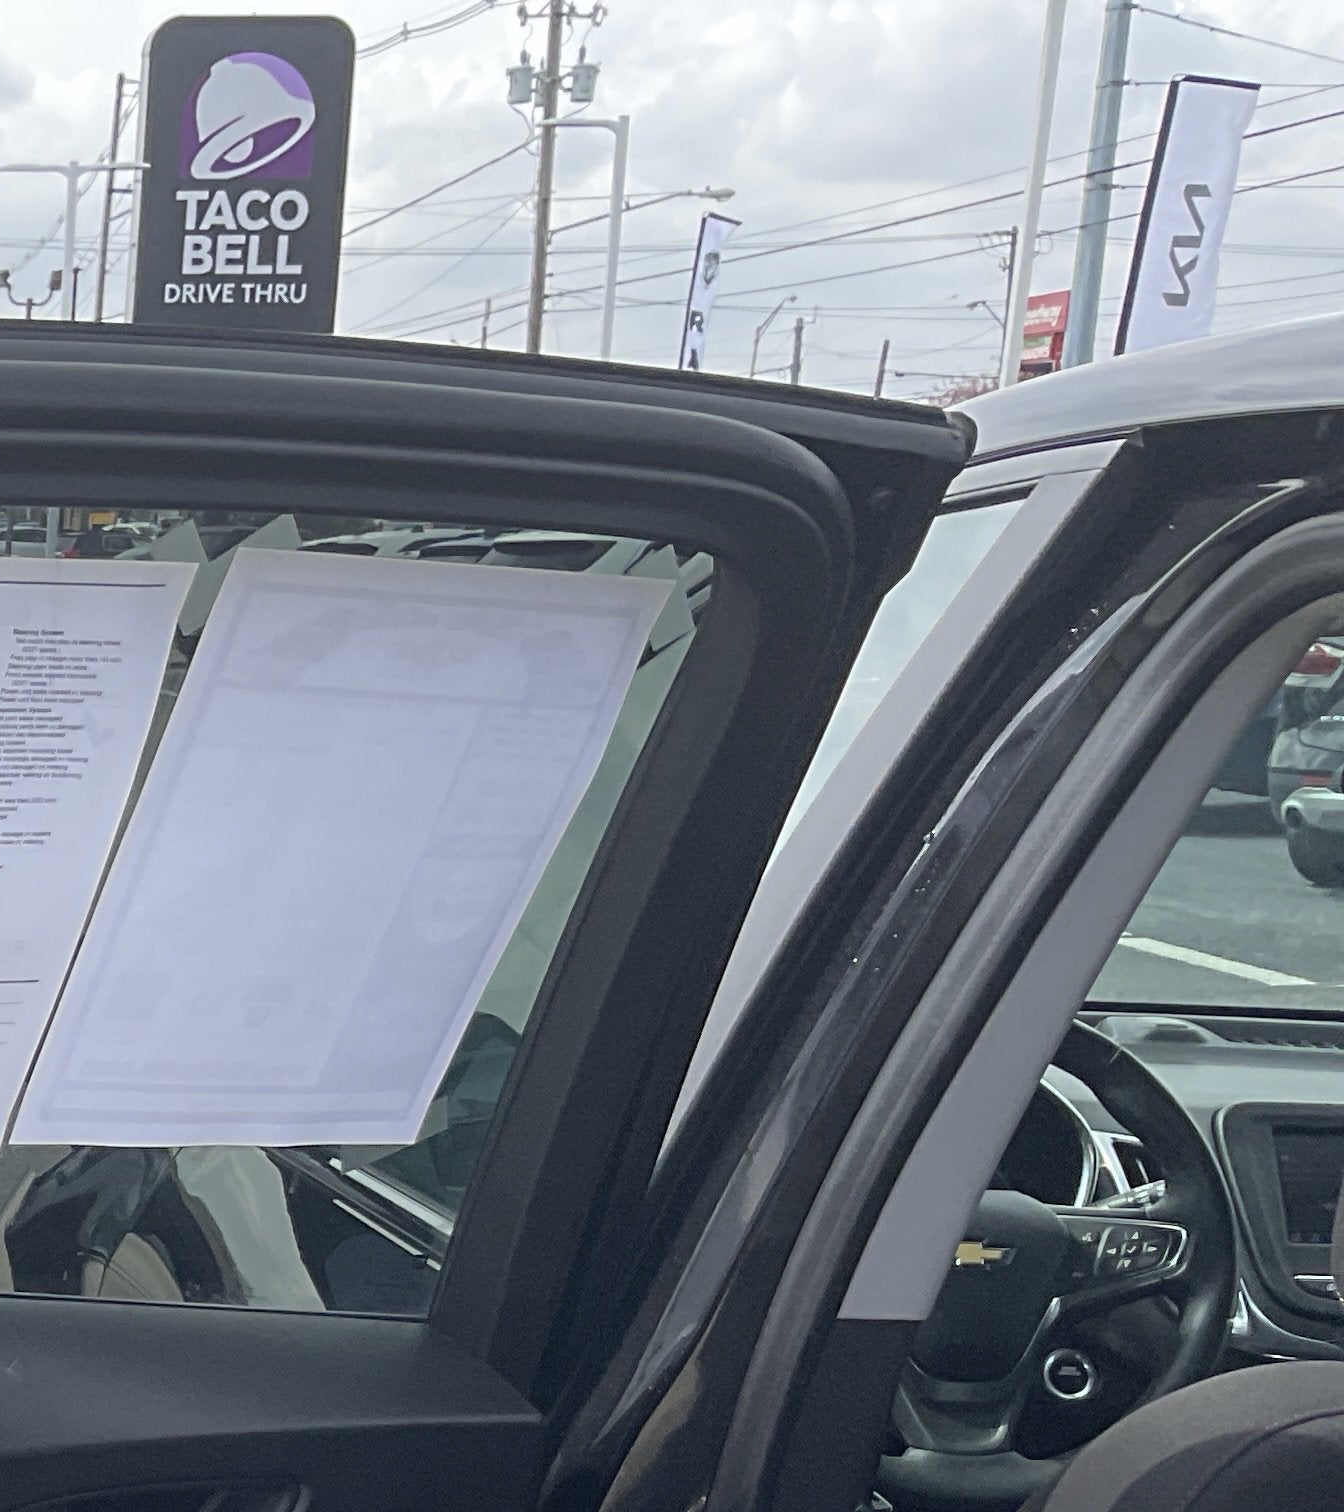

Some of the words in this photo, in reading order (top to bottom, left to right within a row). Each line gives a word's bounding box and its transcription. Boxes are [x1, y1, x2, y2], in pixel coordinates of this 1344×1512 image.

[176, 190, 309, 231] TACO
[181, 234, 302, 275] BELL
[164, 283, 234, 304] DRIVE
[241, 283, 307, 304] THRU
